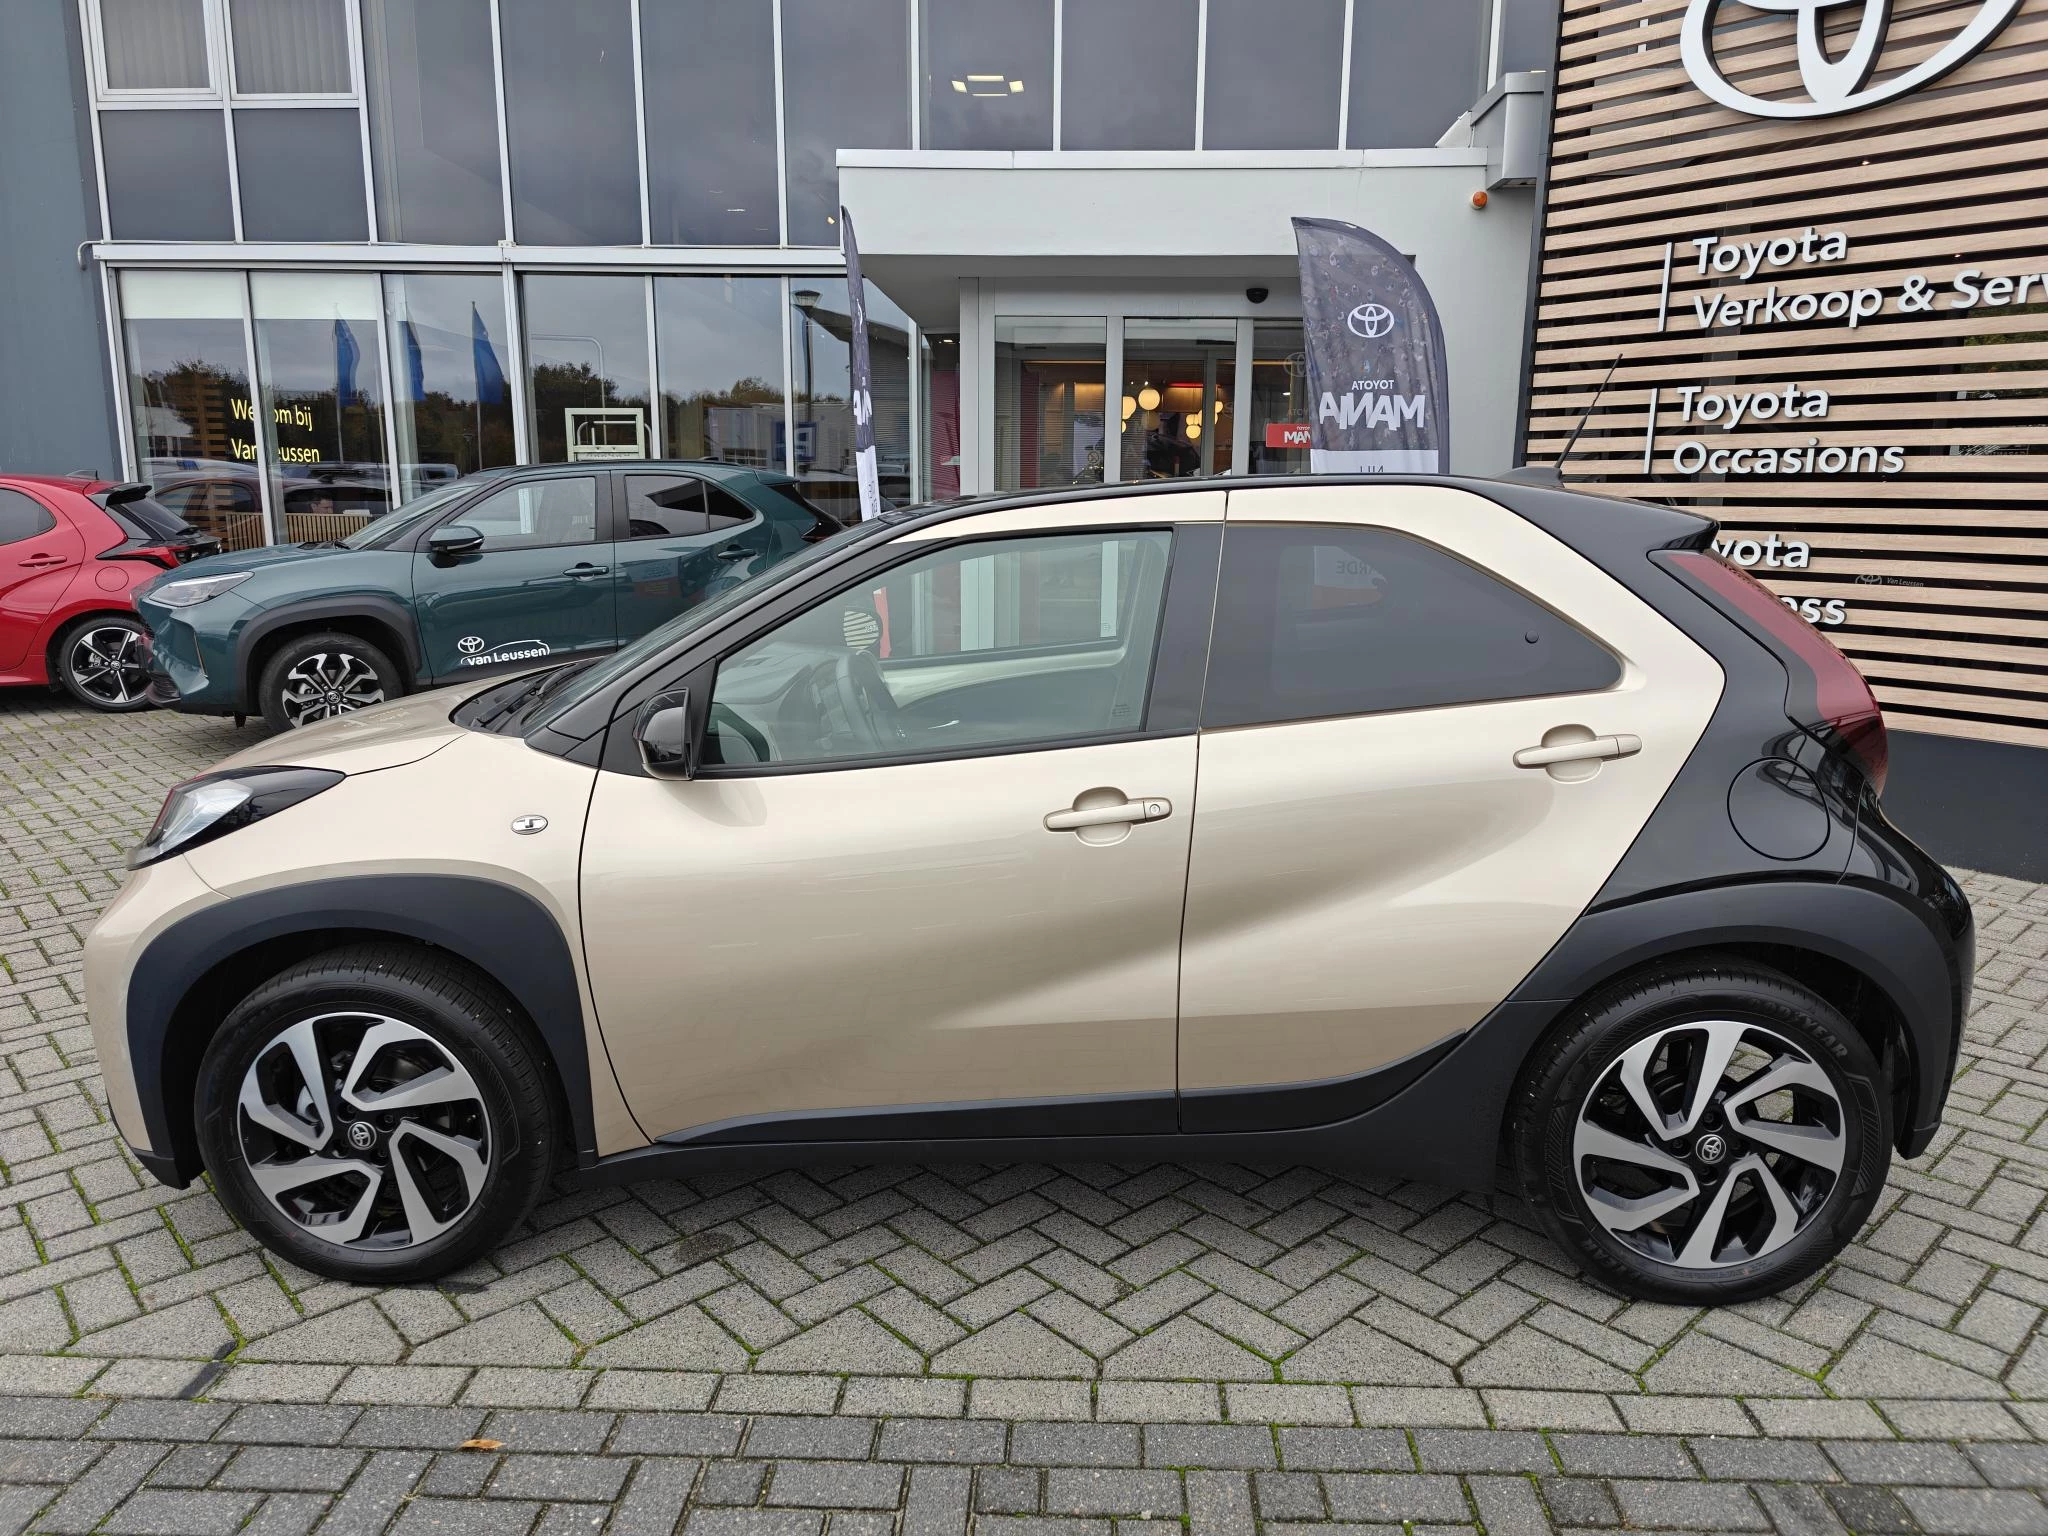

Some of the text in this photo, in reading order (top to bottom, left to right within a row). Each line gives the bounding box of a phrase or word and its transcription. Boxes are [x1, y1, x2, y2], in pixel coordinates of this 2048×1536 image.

[1692, 227, 1849, 280] Toyota
[1693, 286, 1884, 329] Verkoop
[1896, 273, 1937, 314] &
[231, 398, 313, 432] Weom bij
[1676, 383, 1830, 430] Toyota
[277, 446, 320, 463] ussen
[1284, 430, 1311, 445] MAN
[1672, 437, 1906, 474] Occasions
[1711, 533, 1811, 569] yota
[1887, 577, 1899, 585] Van
[467, 647, 547, 666] van Leussen
